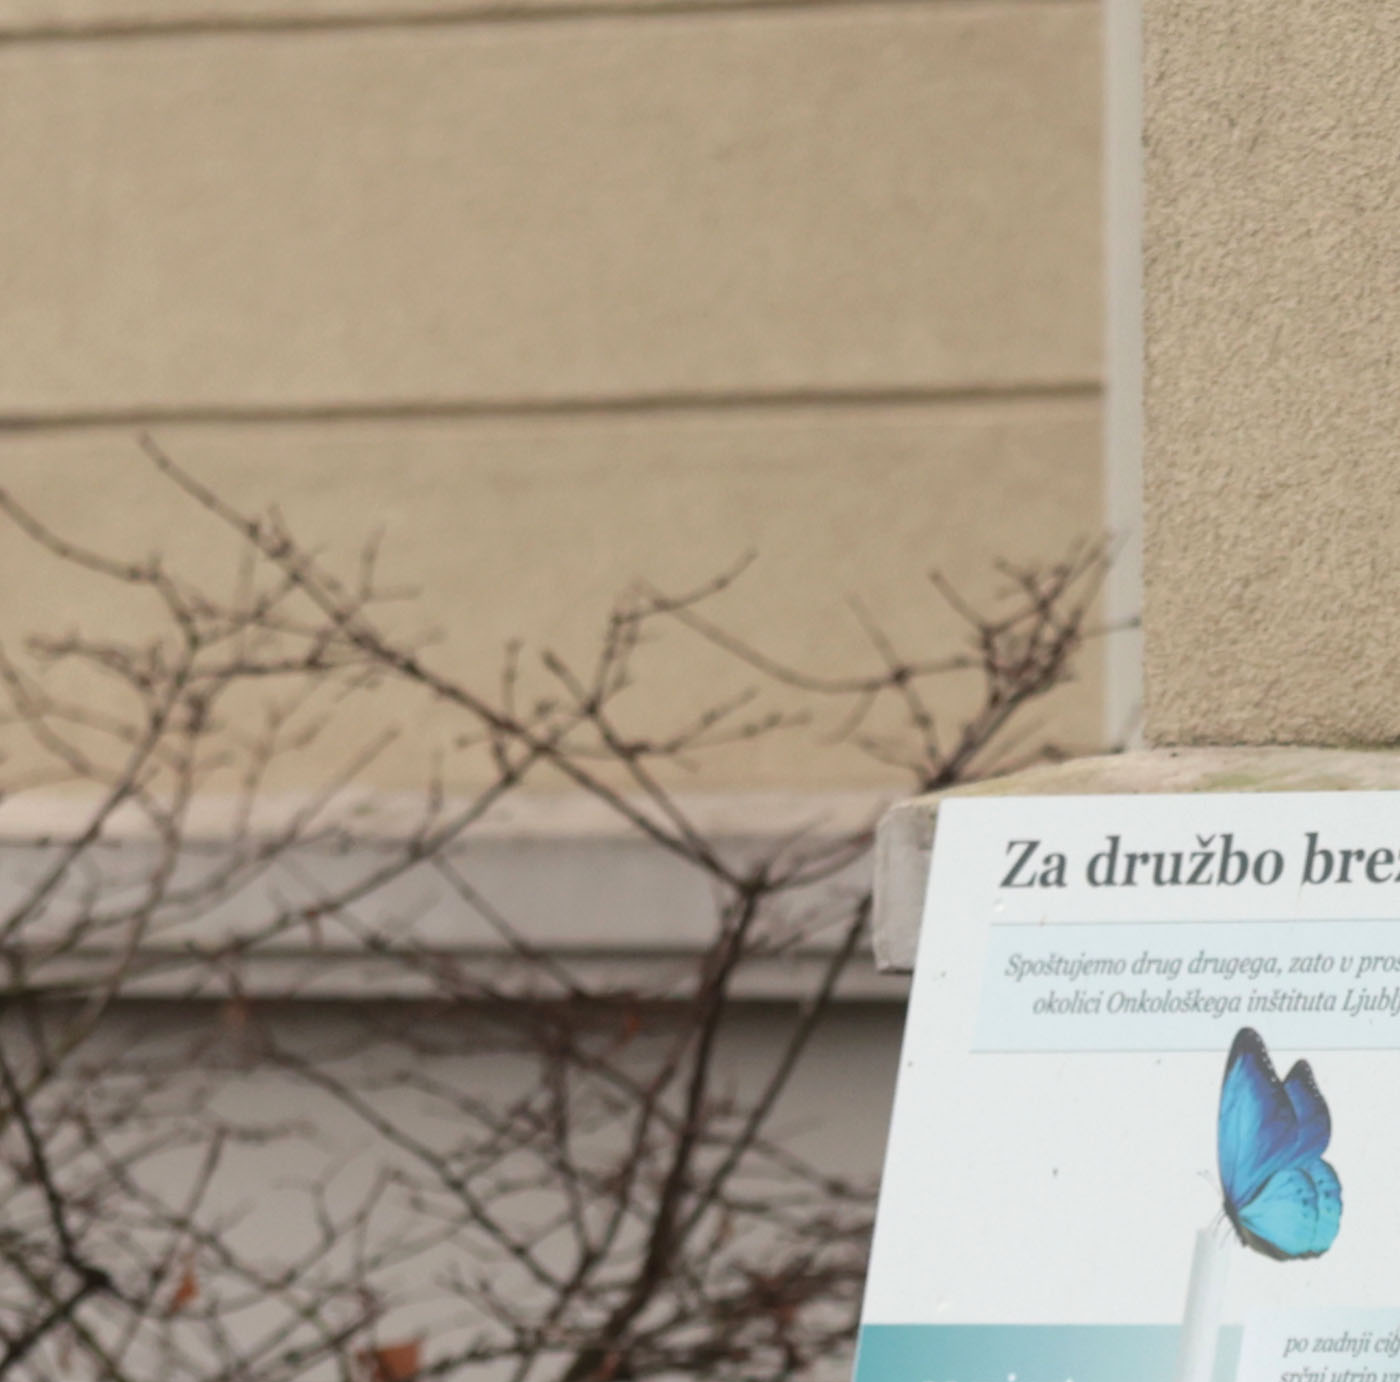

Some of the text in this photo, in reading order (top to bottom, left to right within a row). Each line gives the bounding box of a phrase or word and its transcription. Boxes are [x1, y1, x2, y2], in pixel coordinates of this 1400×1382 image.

[999, 839, 1068, 889] Za
[1086, 834, 1284, 888] družbo
[1004, 951, 1127, 980] Spoštujemo
[1131, 951, 1181, 979] drug
[1187, 950, 1283, 978] drugega,
[1289, 952, 1336, 973] zato
[1340, 957, 1353, 972] v
[1033, 991, 1101, 1015] okolici
[1107, 989, 1241, 1016] Onkološkega
[1247, 988, 1337, 1012] inštituta
[1283, 1335, 1308, 1358] po
[1312, 1332, 1372, 1358] zadnji
